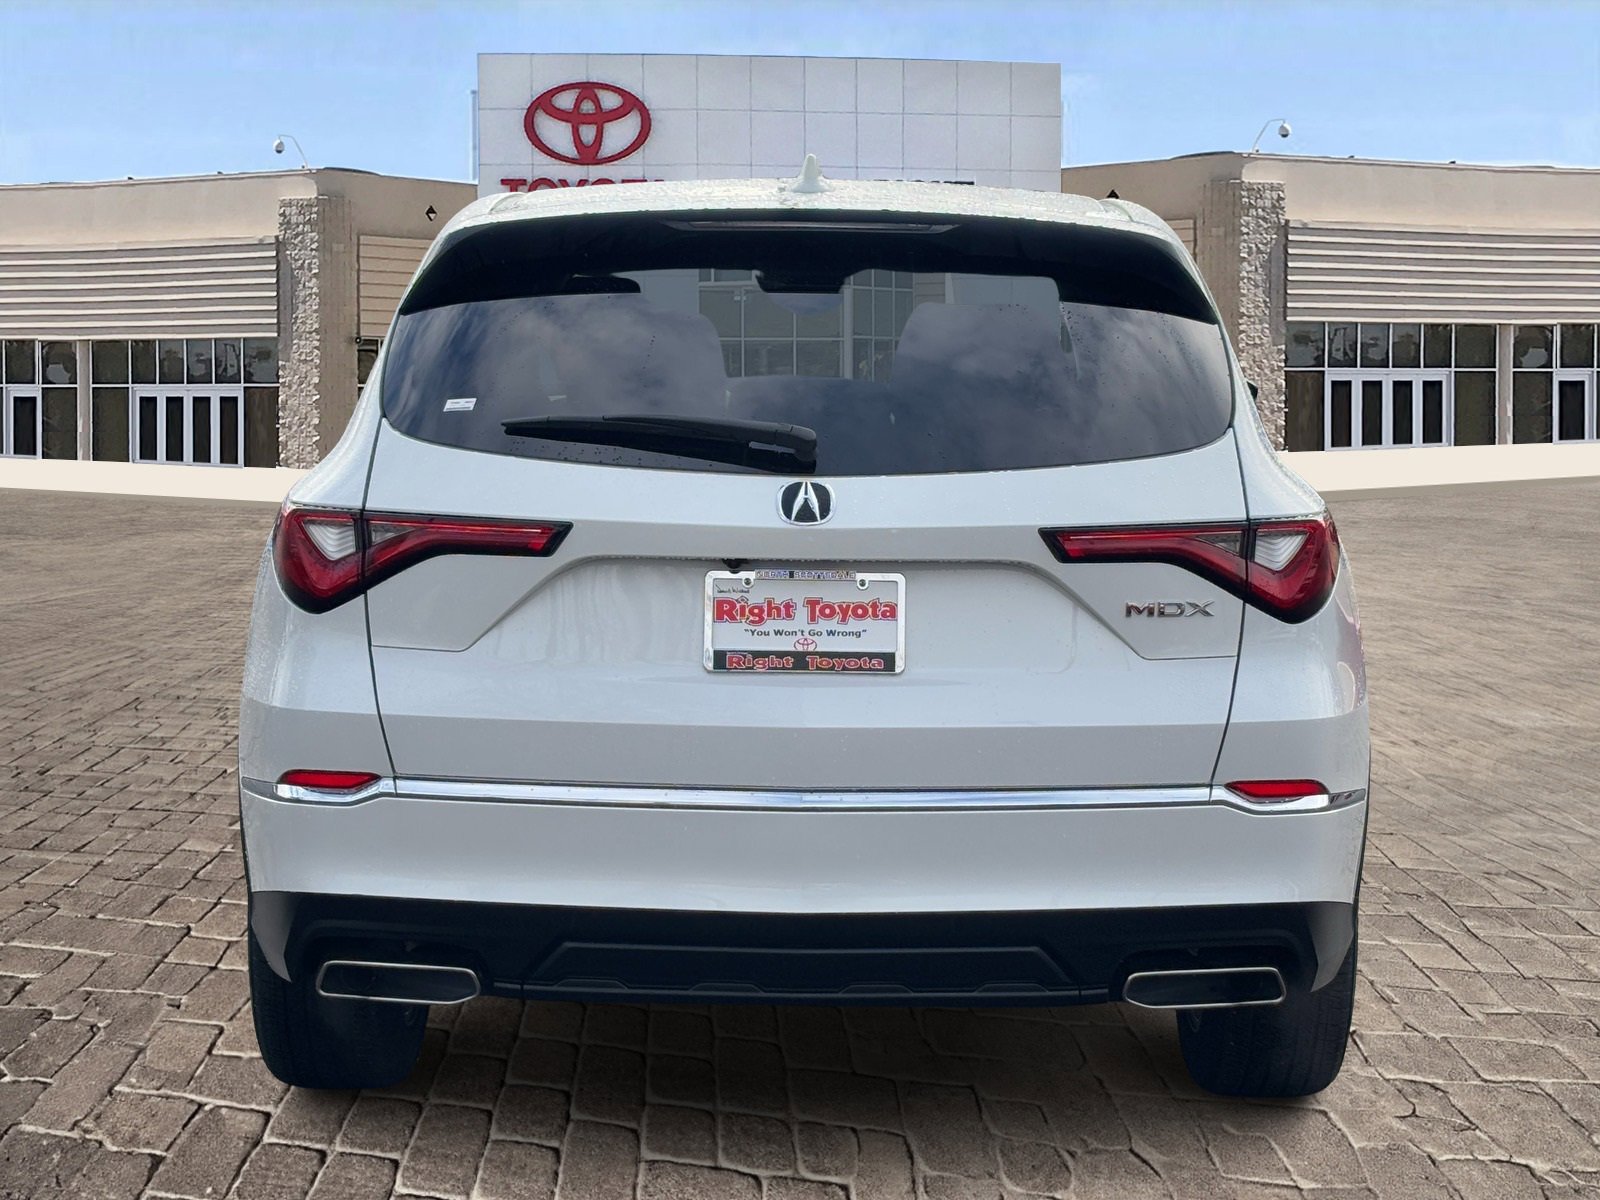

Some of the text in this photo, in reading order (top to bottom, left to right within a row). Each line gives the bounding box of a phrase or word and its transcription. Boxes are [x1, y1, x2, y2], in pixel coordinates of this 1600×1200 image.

[713, 596, 898, 627] Right Toyota
[1125, 600, 1215, 618] MDX
[773, 628, 805, 637] Won't
[808, 628, 823, 637] Go
[726, 653, 885, 671] Right Toyota
